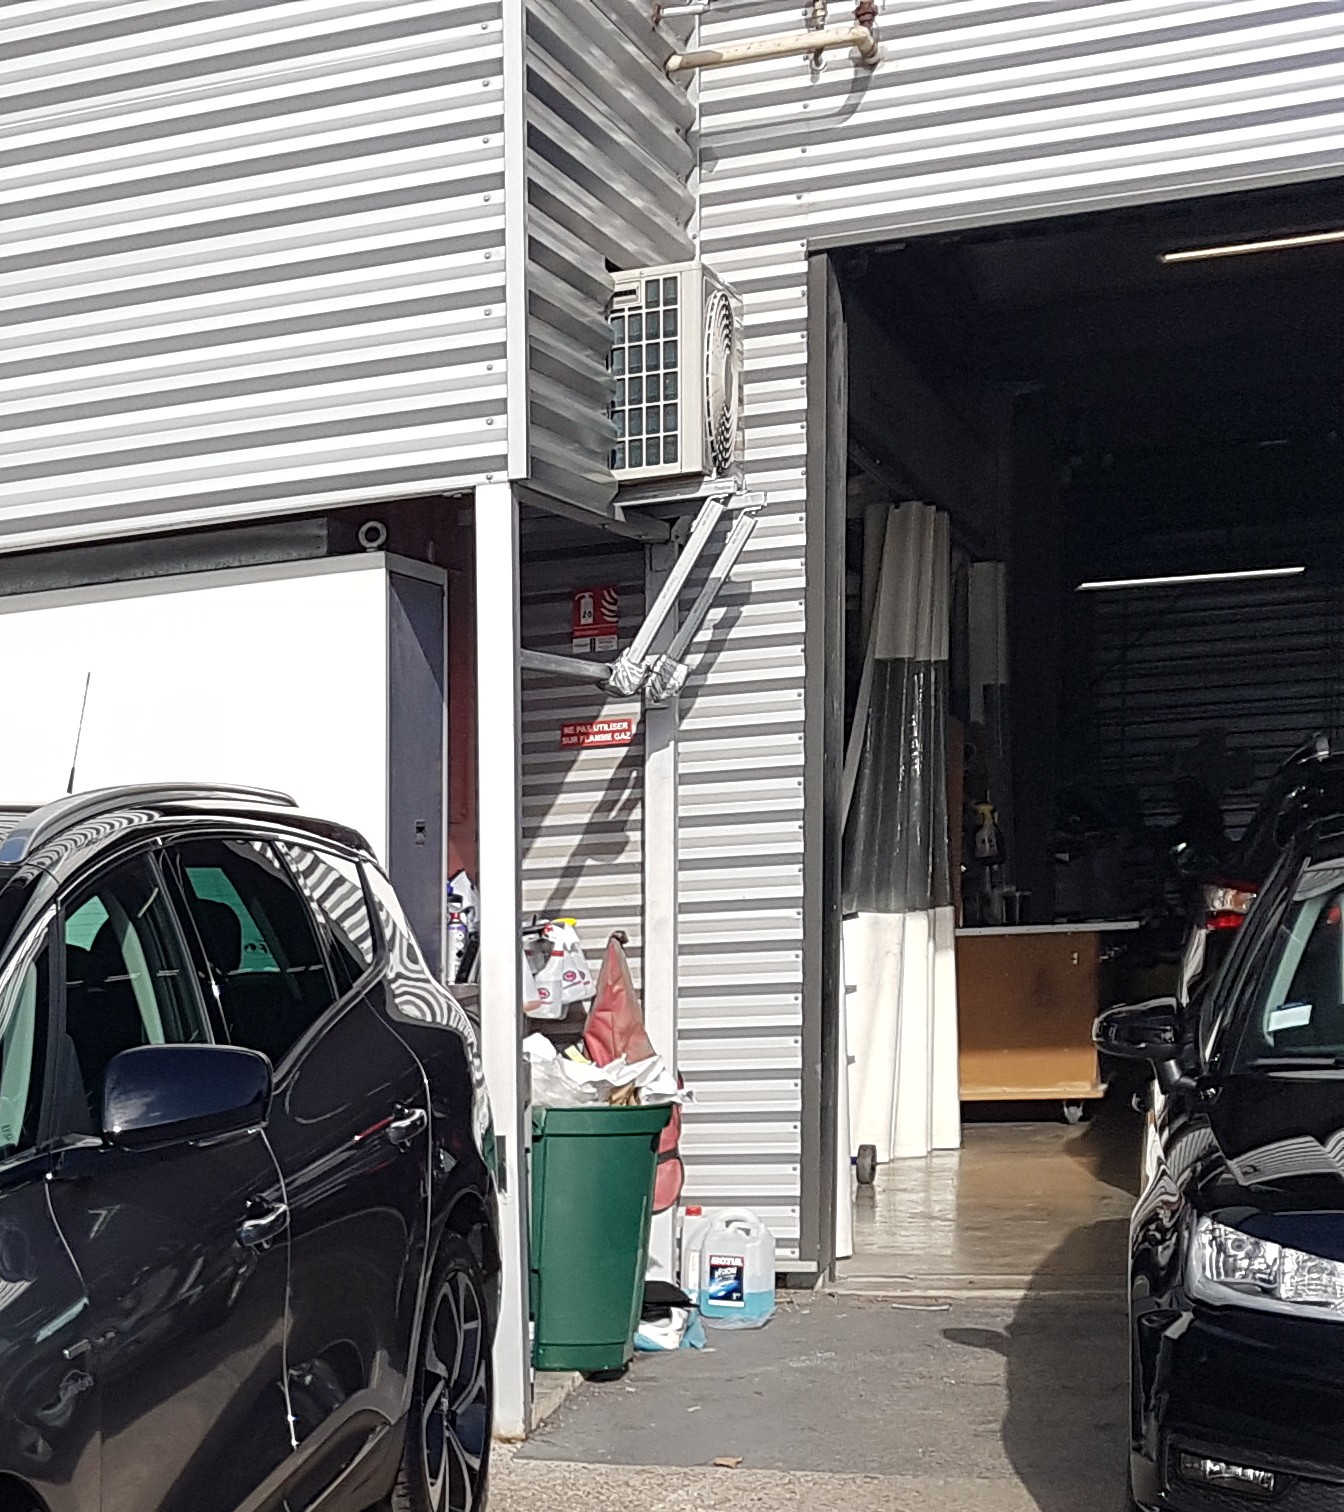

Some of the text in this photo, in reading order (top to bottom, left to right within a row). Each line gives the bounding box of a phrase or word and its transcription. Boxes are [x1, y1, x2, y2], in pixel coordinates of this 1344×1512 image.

[576, 725, 592, 734] PAS
[593, 722, 629, 732] UTILISER
[614, 732, 631, 740] GAZ
